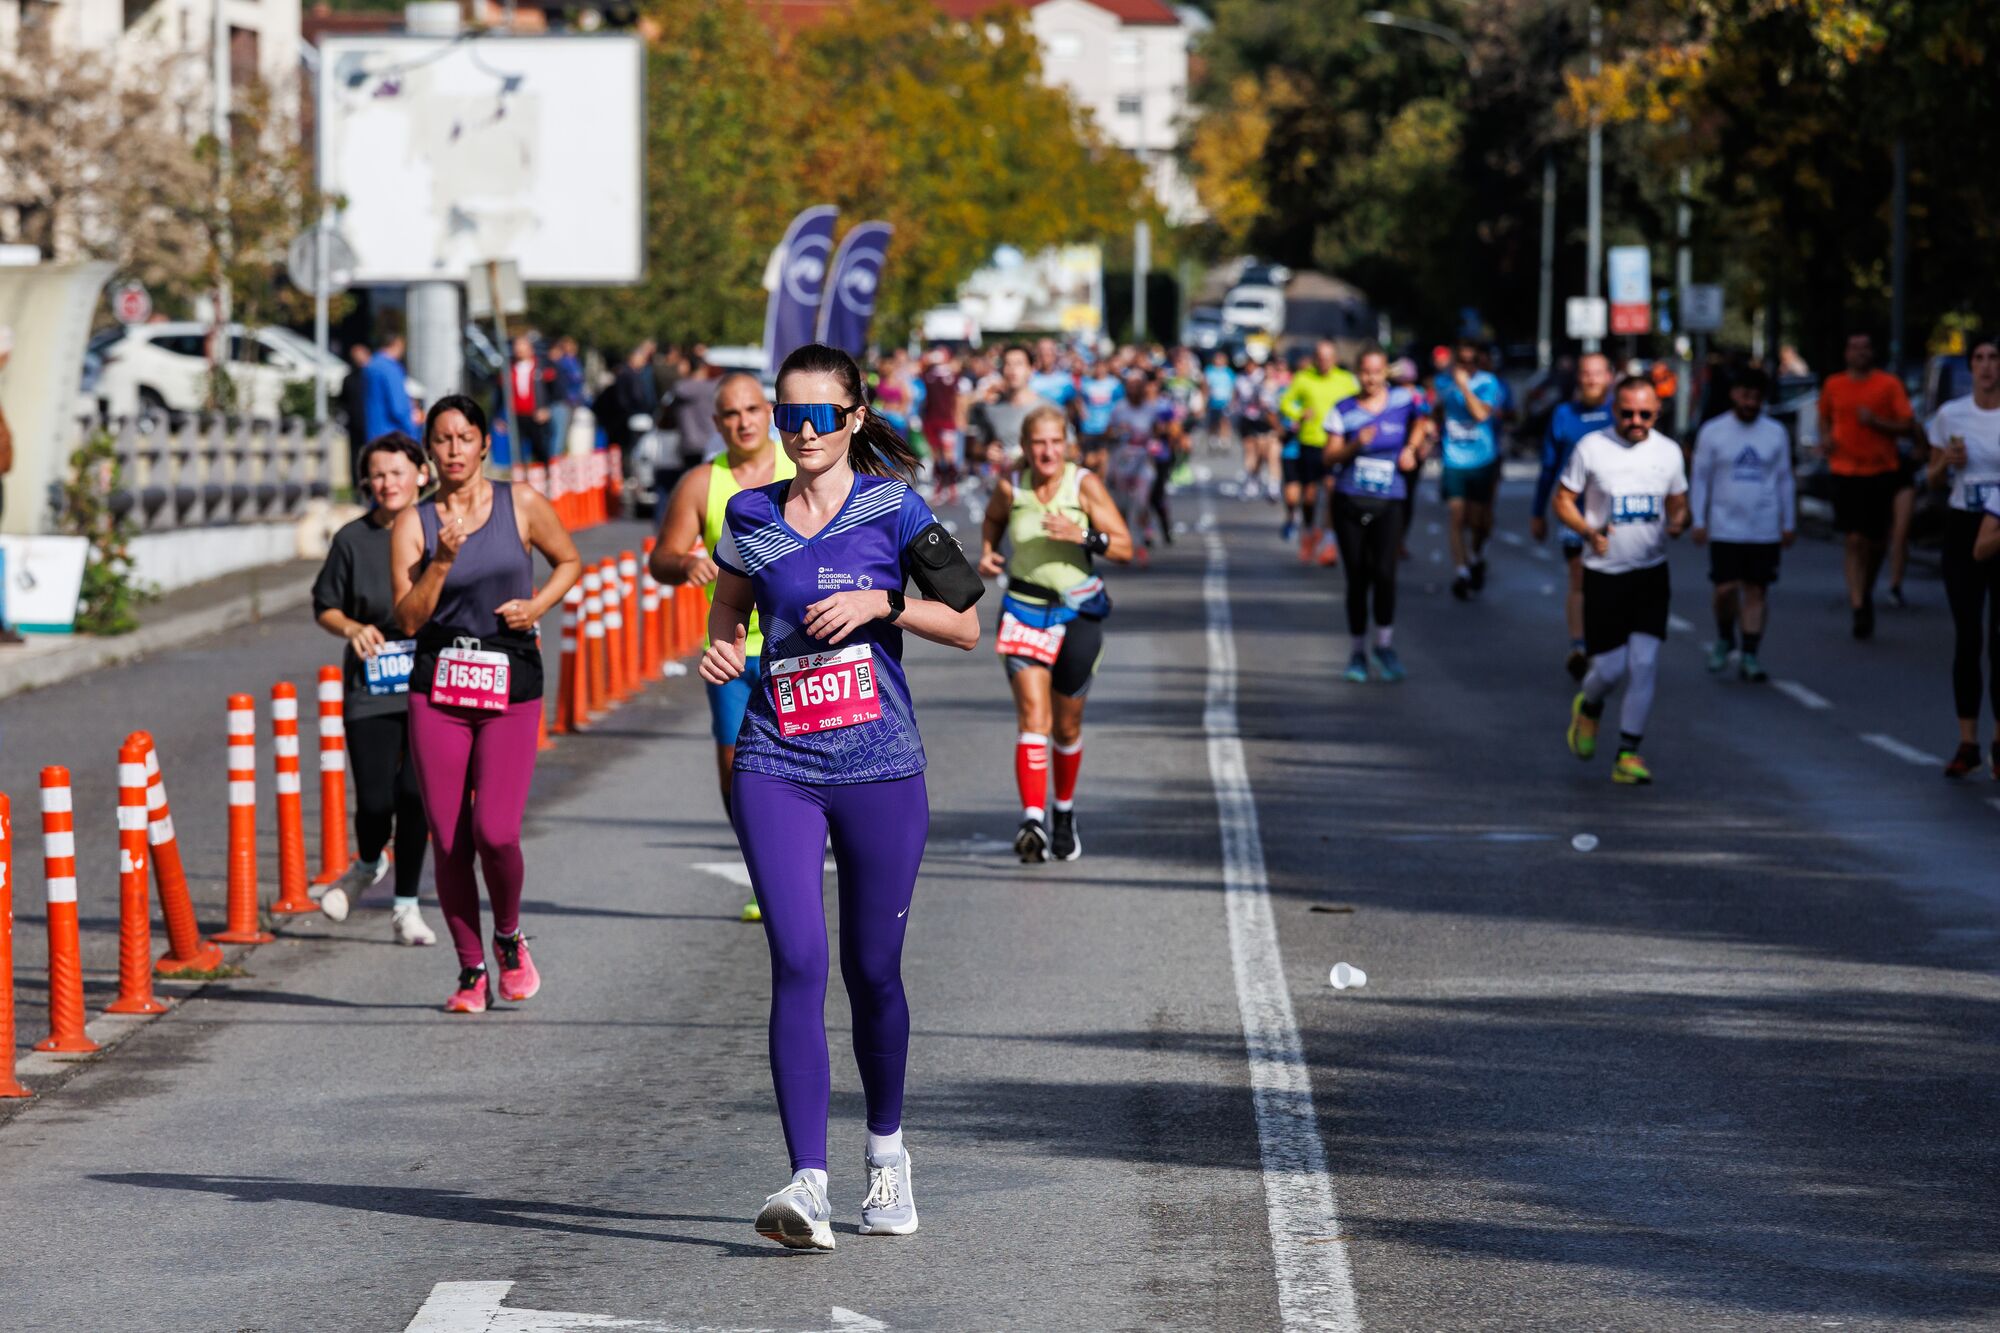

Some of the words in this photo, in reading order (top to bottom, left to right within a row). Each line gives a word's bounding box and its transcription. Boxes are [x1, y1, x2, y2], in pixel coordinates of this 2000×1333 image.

[450, 664, 493, 690] 1535
[796, 670, 851, 706] 1597
[819, 716, 843, 728] 2025
